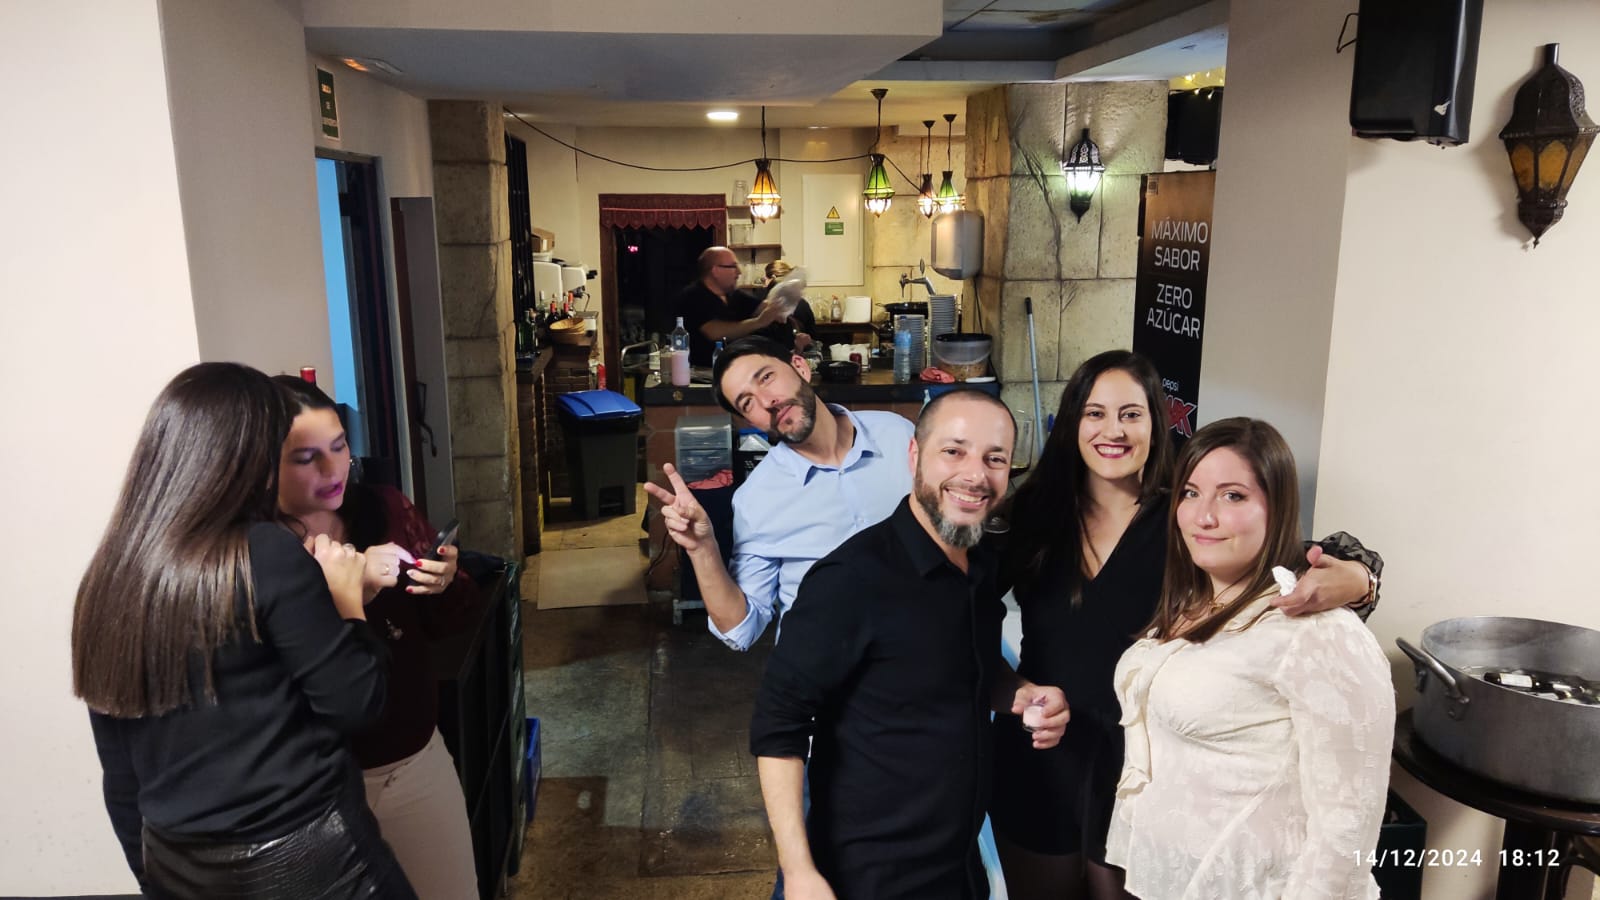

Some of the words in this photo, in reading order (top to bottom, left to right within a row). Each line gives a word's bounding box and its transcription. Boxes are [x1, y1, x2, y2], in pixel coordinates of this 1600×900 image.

[1151, 217, 1209, 244] MÁXIMO
[1154, 246, 1200, 271] SABOR
[1156, 283, 1193, 309] ZERO
[1146, 307, 1200, 339] AZÚCAR
